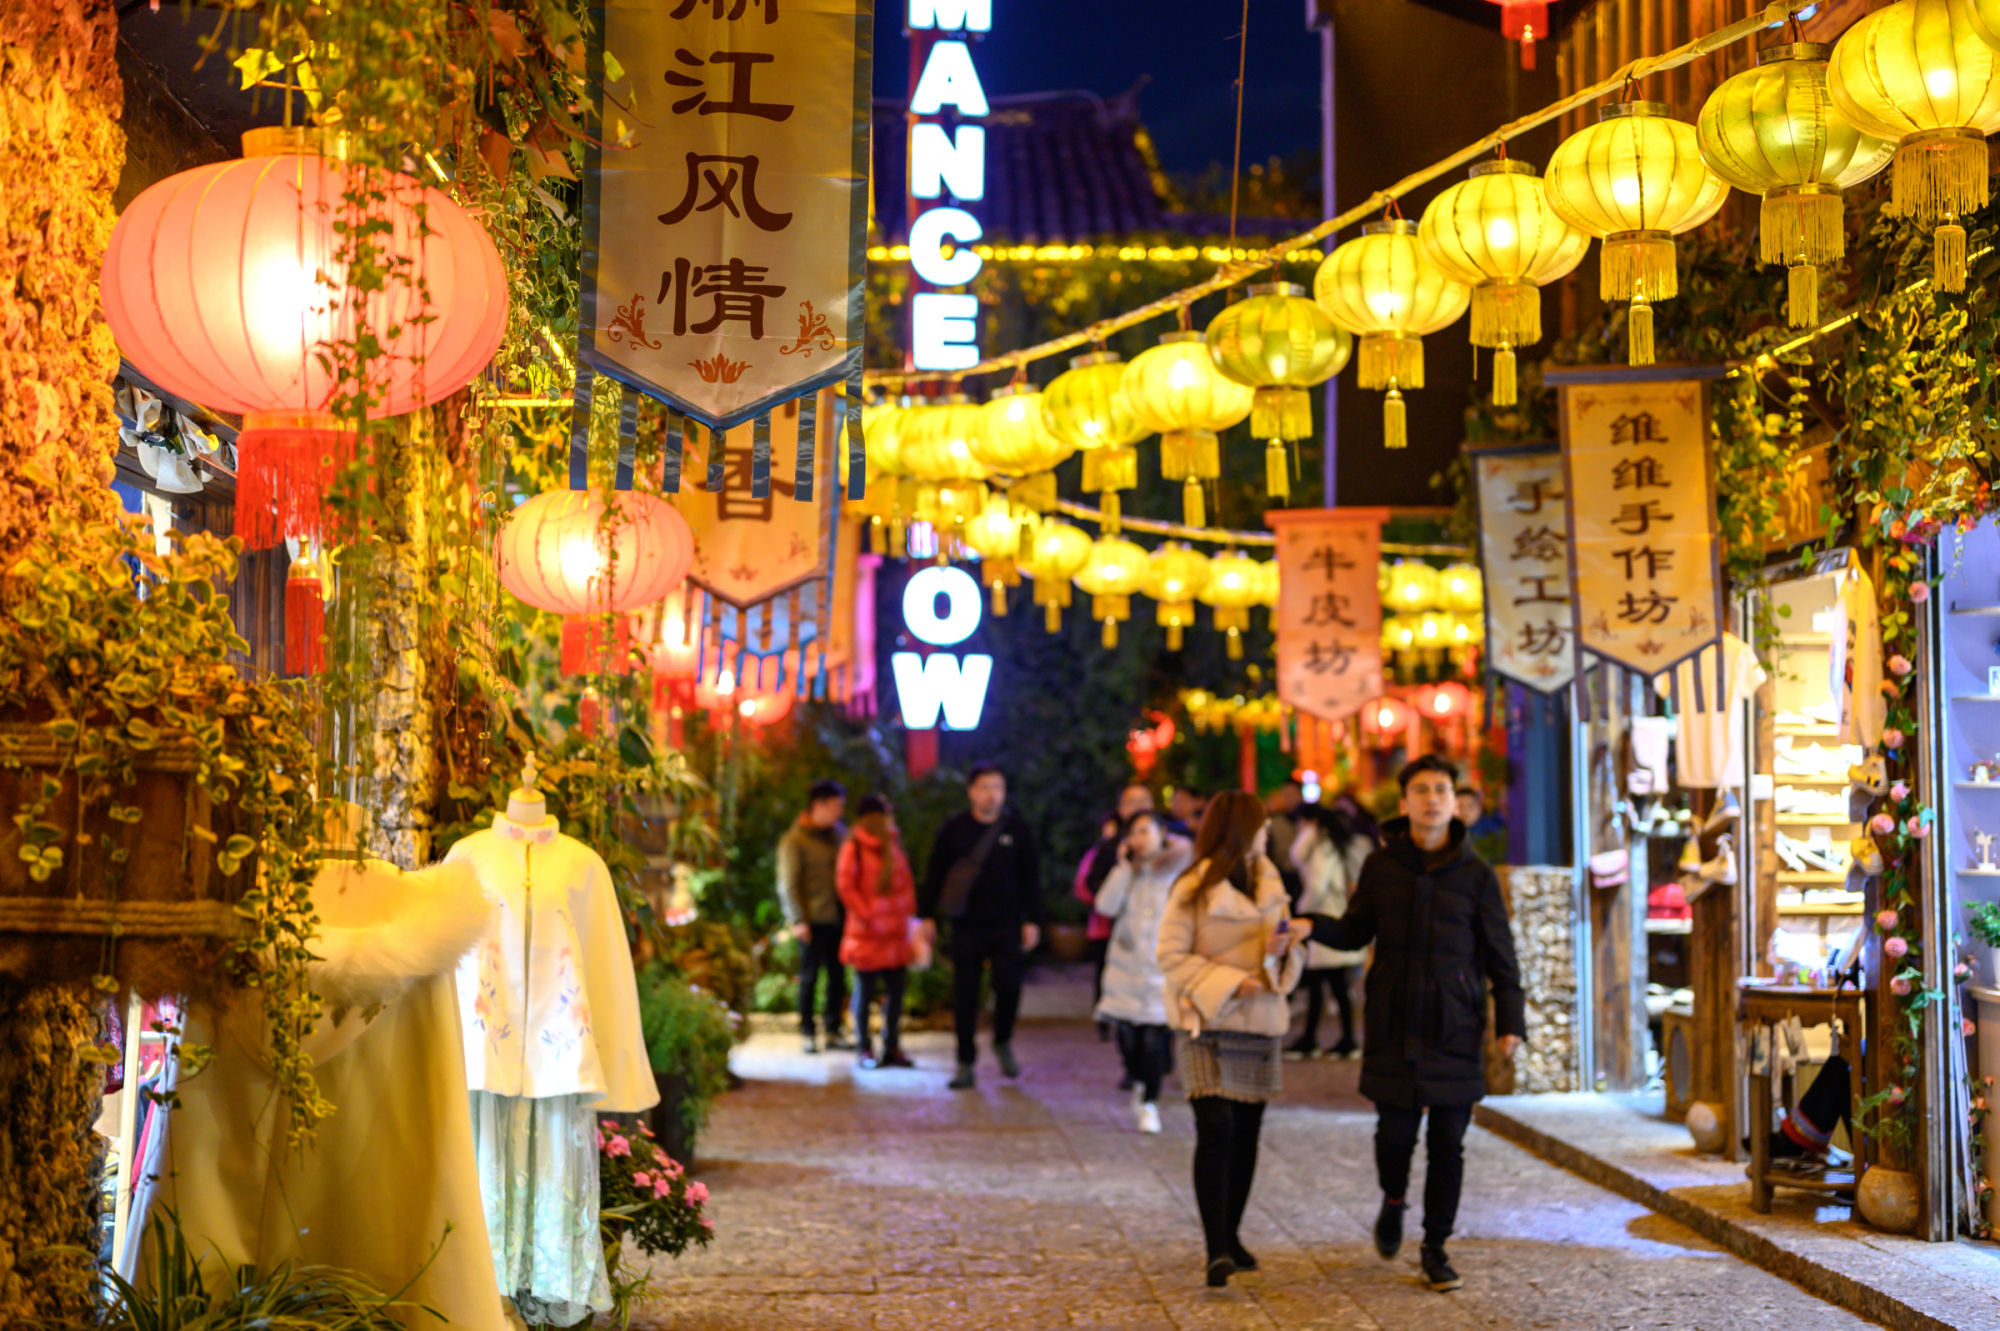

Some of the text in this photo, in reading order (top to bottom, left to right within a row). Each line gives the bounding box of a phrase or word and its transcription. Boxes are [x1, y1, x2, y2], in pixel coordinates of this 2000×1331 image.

[1609, 410, 1678, 624] 维维手作坊
[1302, 544, 1358, 676] 牛皮坊
